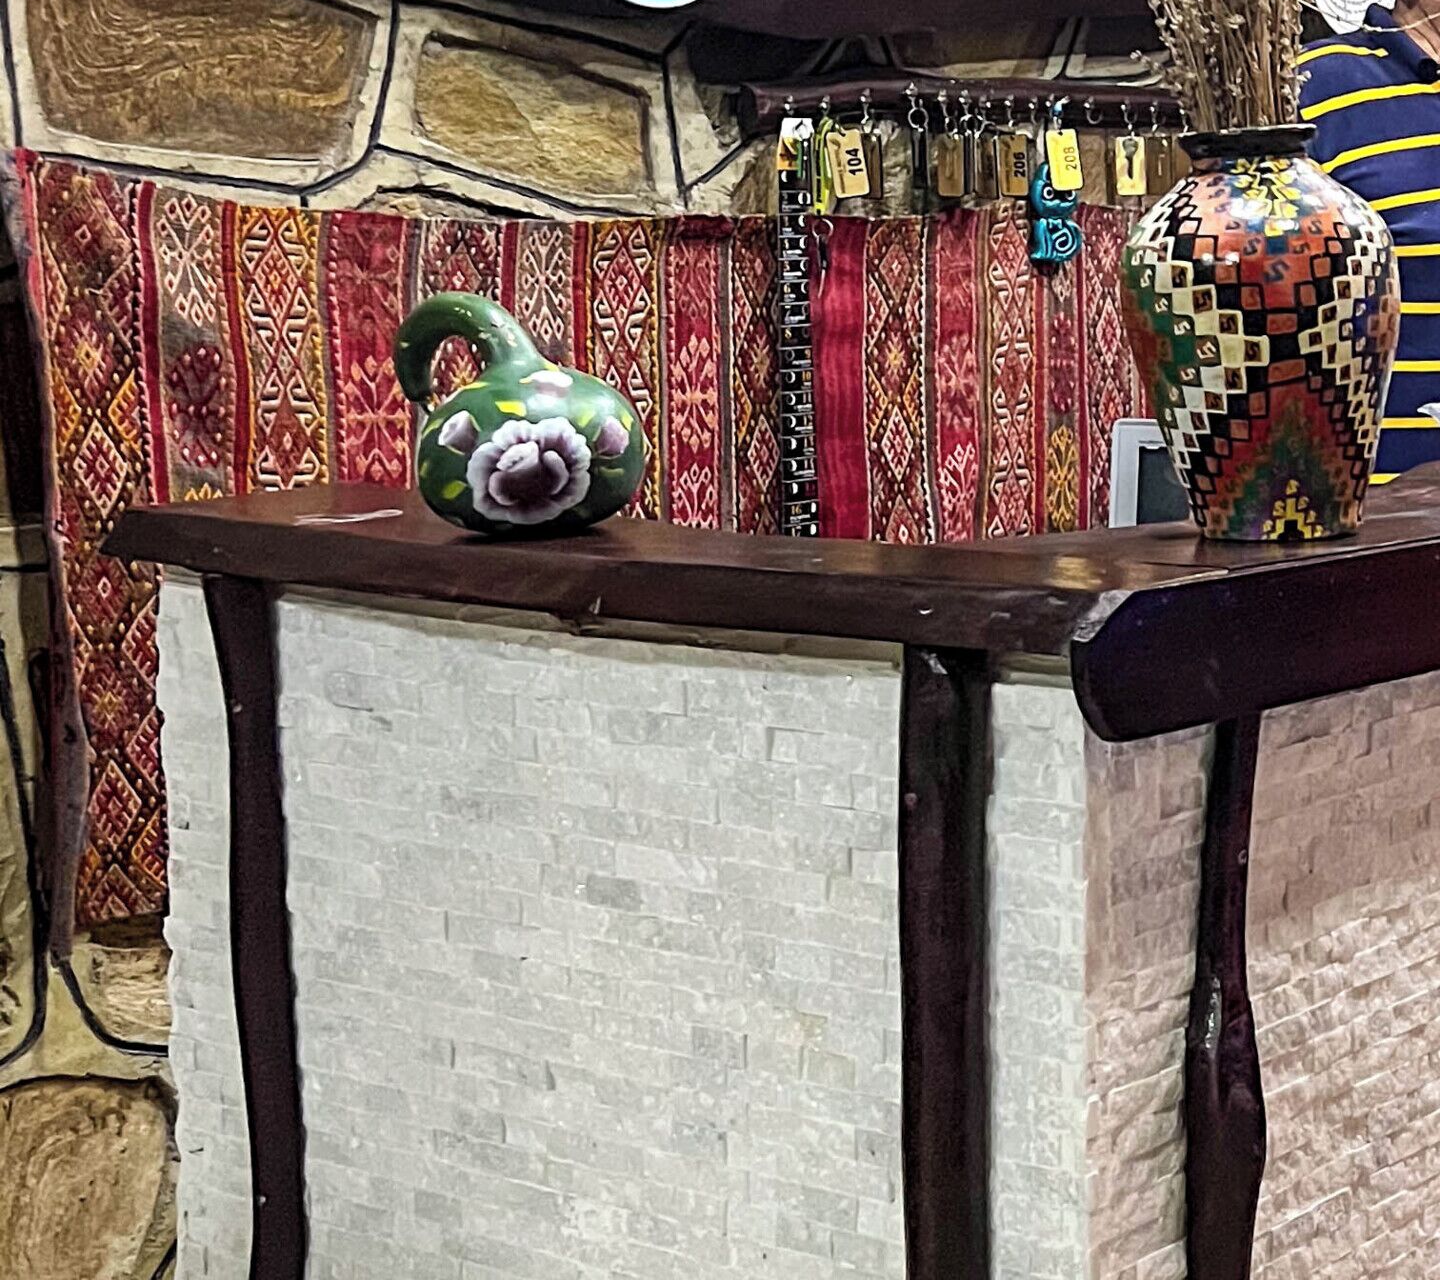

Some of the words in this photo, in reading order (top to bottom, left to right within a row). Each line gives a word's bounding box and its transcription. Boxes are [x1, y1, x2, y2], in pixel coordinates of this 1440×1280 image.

[845, 148, 864, 176] 104
[1013, 151, 1026, 178] 206
[1063, 146, 1078, 172] 208
